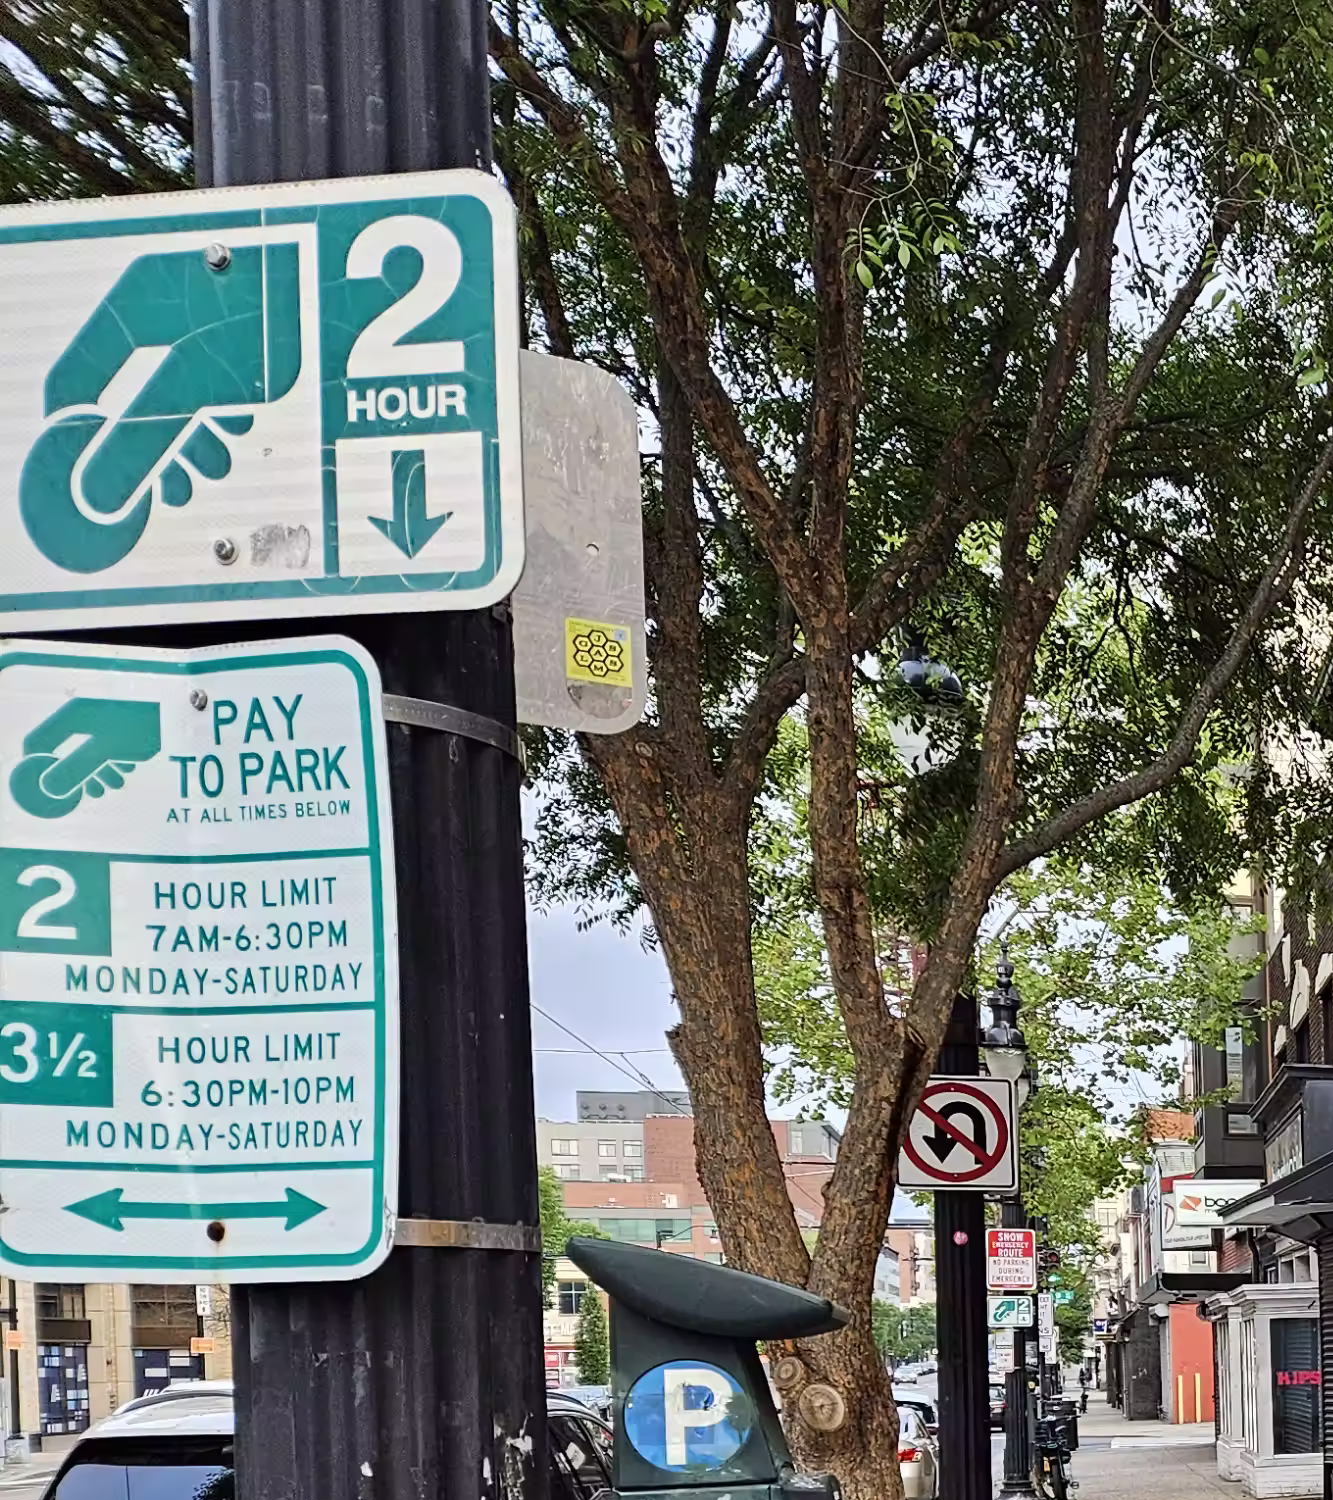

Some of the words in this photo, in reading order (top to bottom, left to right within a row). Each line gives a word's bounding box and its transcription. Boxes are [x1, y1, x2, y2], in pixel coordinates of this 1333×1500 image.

[345, 214, 465, 378] 2
[347, 384, 467, 422] HOUR
[213, 694, 303, 745] PAY
[169, 754, 224, 798] TO
[240, 746, 351, 795] PARK
[166, 808, 191, 823] AT
[200, 806, 233, 822] ALL
[239, 804, 288, 821] TIMES
[295, 799, 351, 818] BELOW
[16, 865, 78, 940] 2
[154, 882, 247, 910] HOUR
[261, 877, 337, 908] LIMIT
[146, 920, 348, 952] 7AM-6:30PM
[65, 962, 363, 996] MONDAY-SATURDAY
[158, 1035, 250, 1065] HOUR
[265, 1032, 340, 1062] LIMIT
[141, 1076, 355, 1108] 6:30PM-10PM
[66, 1119, 363, 1151] MONDAY-SATURDAY
[997, 1232, 1024, 1241] SNOW
[997, 1249, 1024, 1257] ROUTE
[998, 1267, 1024, 1275] DURING
[1018, 1299, 1029, 1311] 2
[664, 1369, 733, 1466] P
